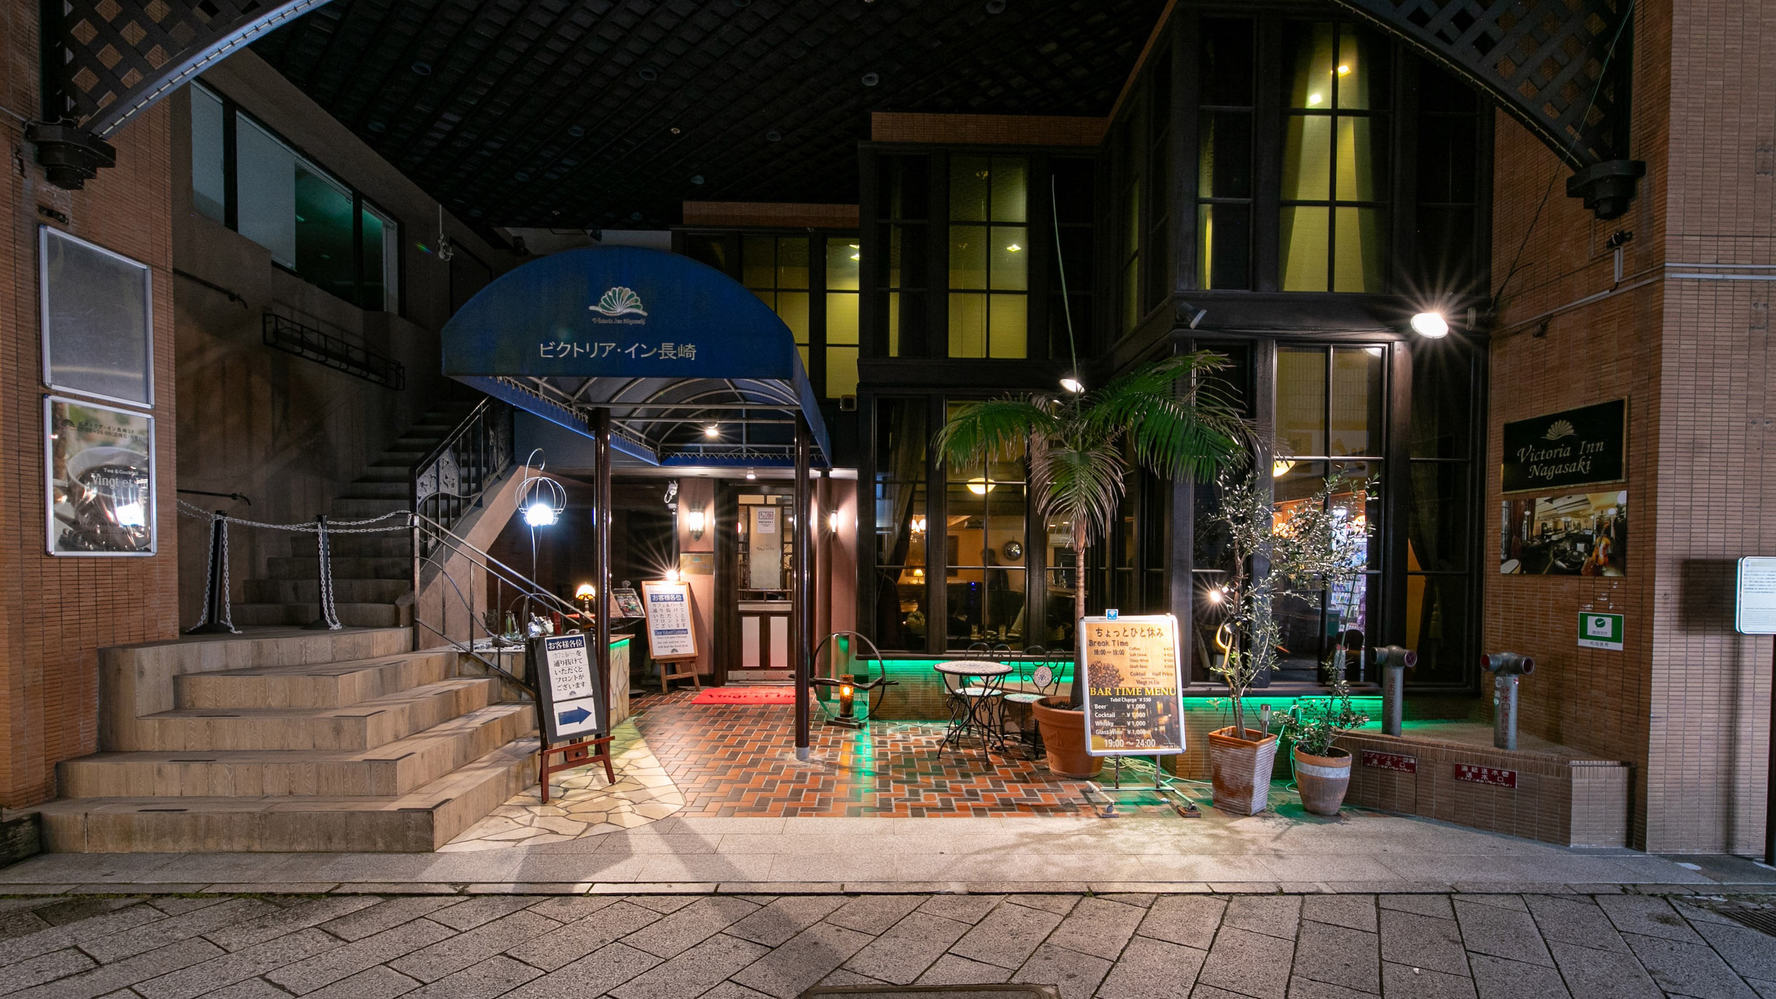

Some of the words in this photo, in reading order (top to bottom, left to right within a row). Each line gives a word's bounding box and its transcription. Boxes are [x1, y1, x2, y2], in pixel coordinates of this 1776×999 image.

[539, 341, 697, 361] ビクトリア・イン長崎
[1516, 443, 1571, 463] Victoria
[1579, 440, 1605, 455] Inn
[1528, 456, 1592, 480] Nagasaki
[1096, 627, 1164, 638] ちょっとひと休み
[553, 658, 583, 667] 通り抜けて
[554, 667, 583, 676] いただくと
[556, 675, 585, 683] フロントが
[557, 681, 585, 691] ございます
[1089, 687, 1113, 696] BAR
[1114, 687, 1142, 696] TIME
[1144, 687, 1176, 696] MENU
